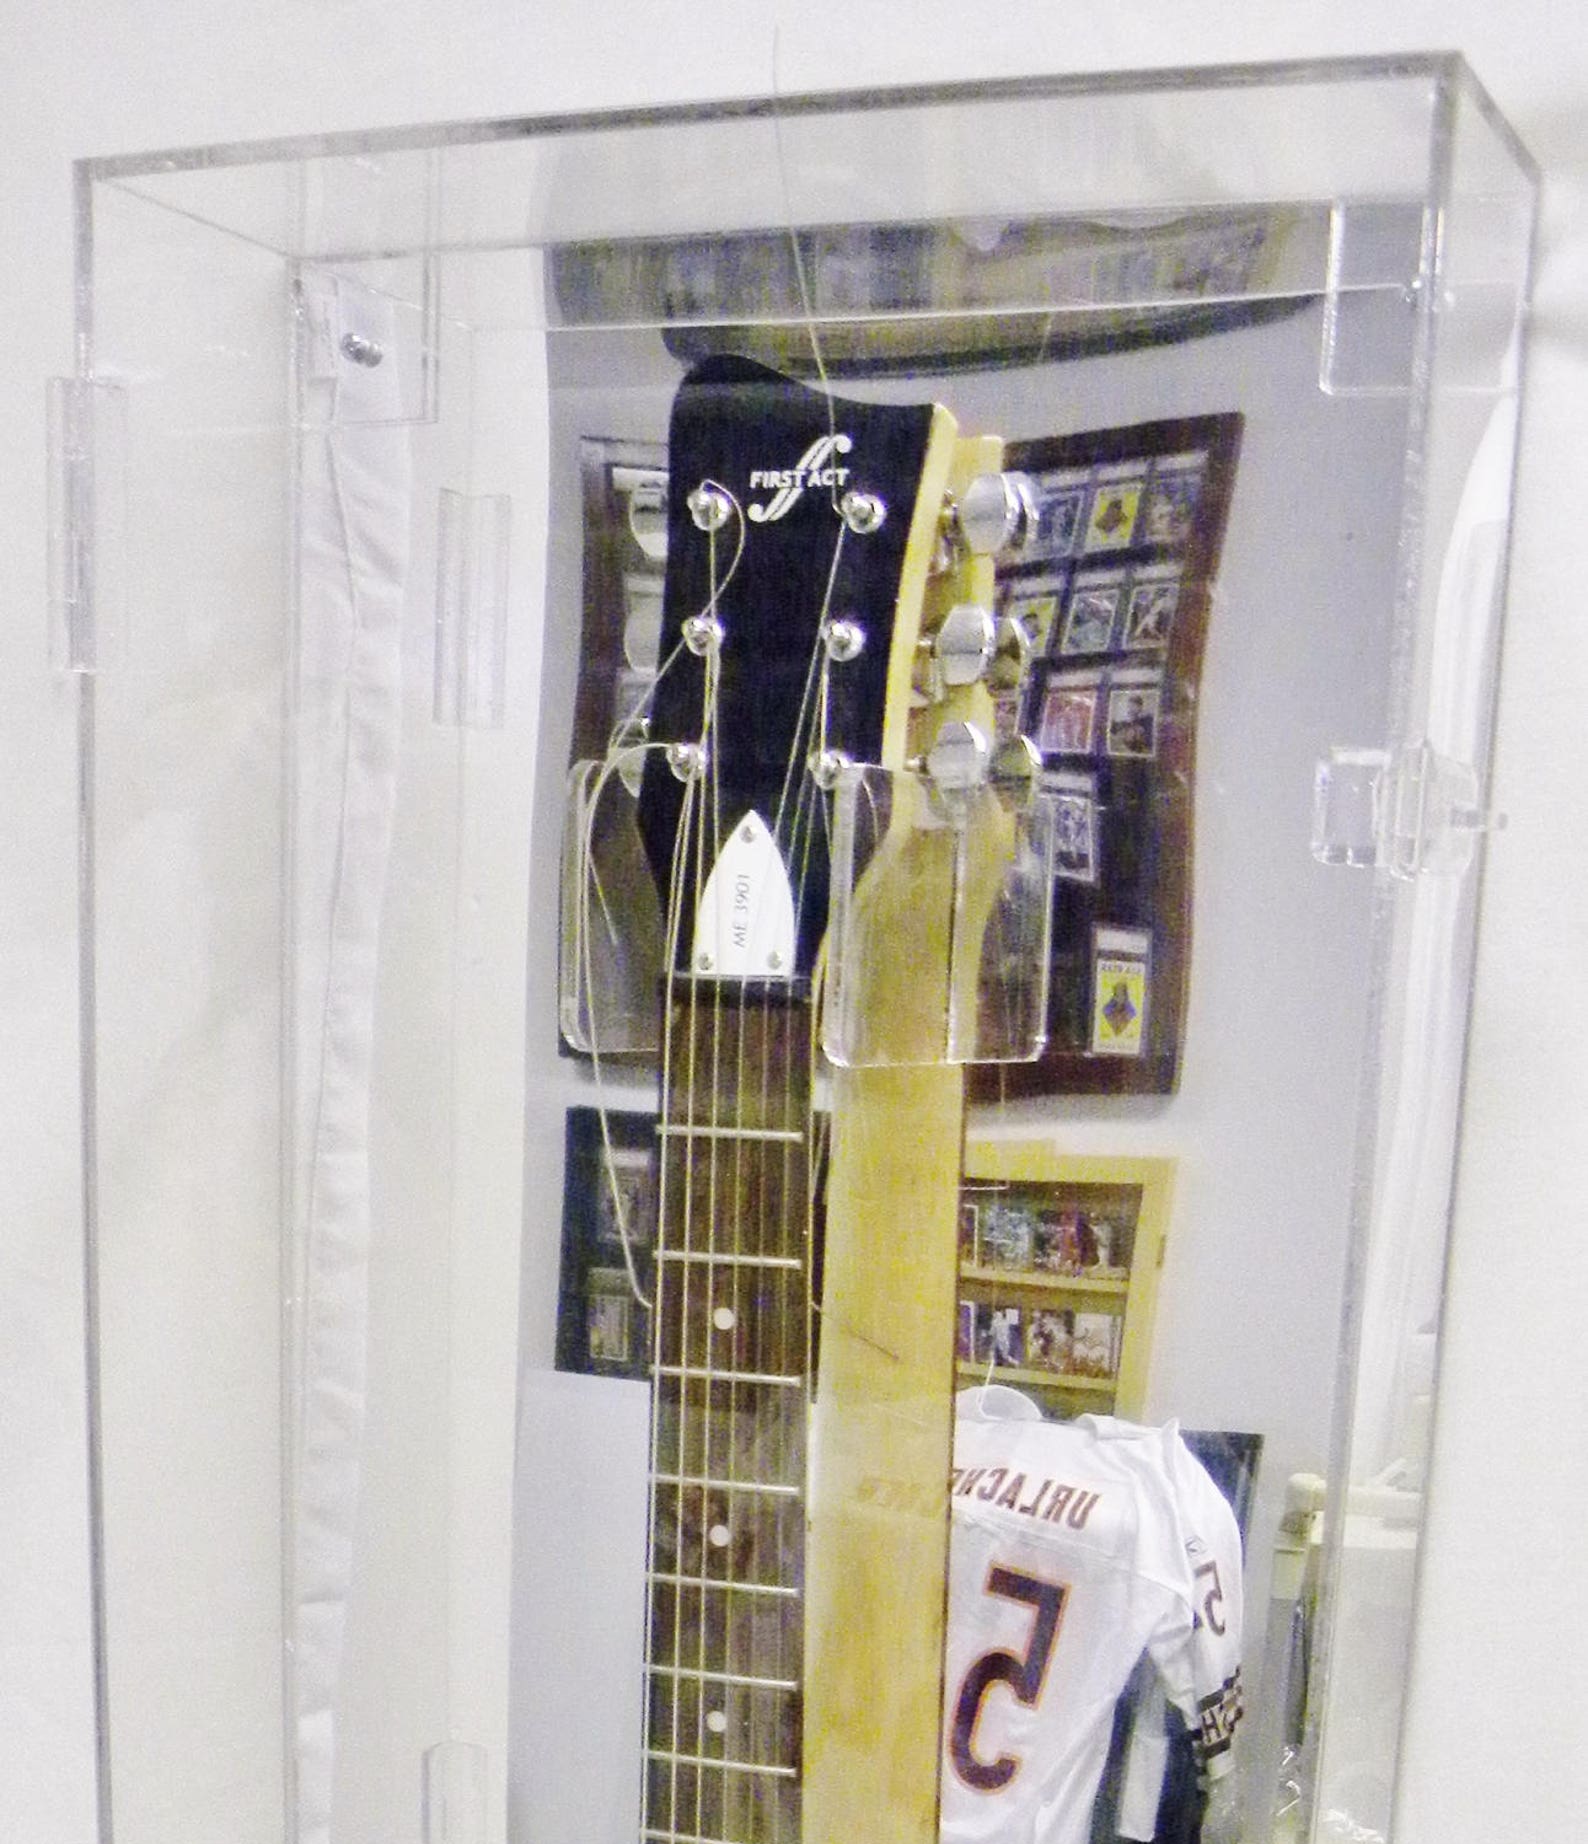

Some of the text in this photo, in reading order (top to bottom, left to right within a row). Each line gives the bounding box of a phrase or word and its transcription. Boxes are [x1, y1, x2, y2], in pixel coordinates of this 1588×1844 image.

[749, 468, 850, 489] FIRST ACT
[731, 920, 748, 949] ME
